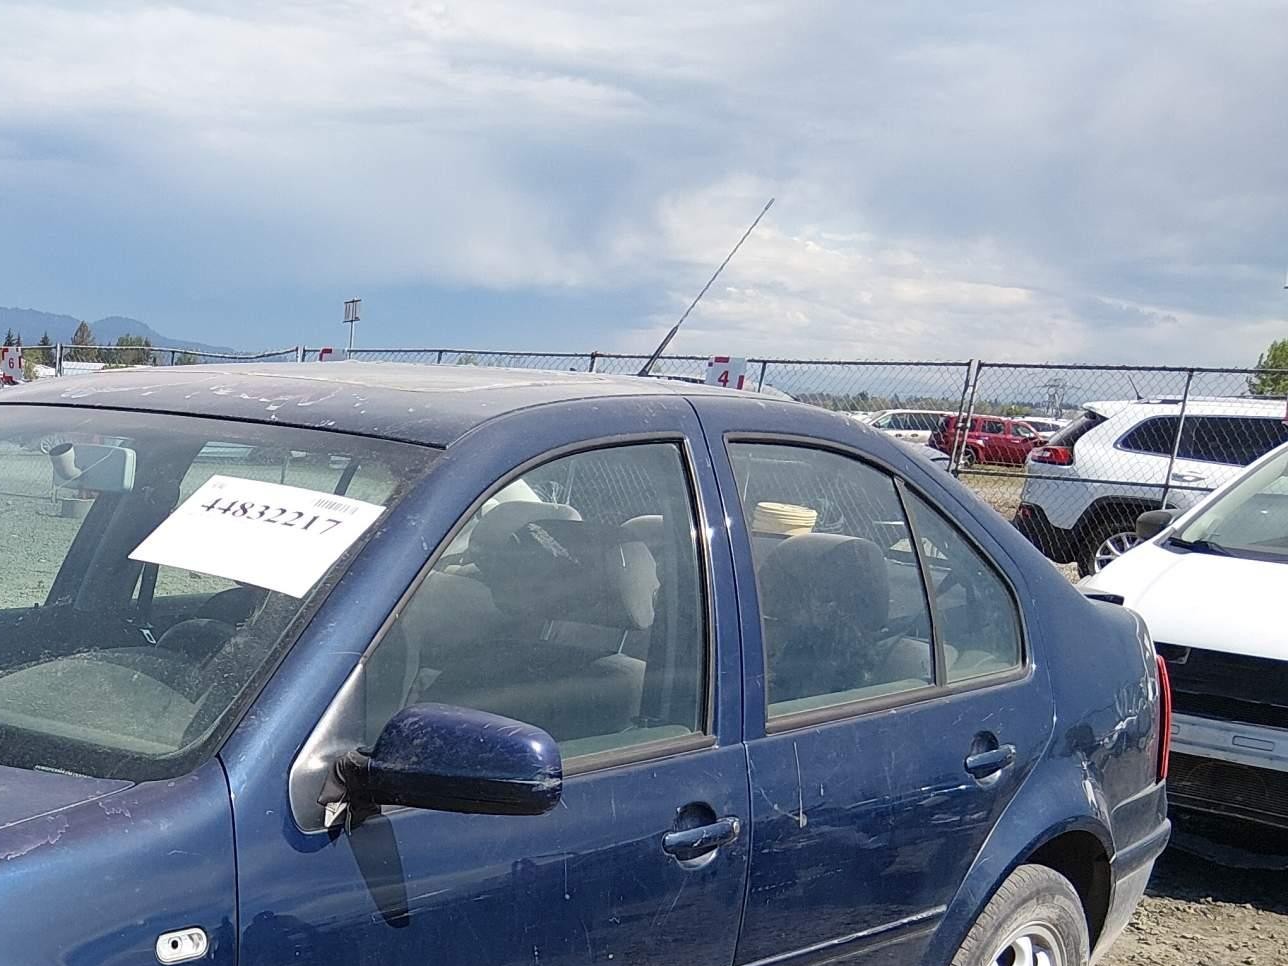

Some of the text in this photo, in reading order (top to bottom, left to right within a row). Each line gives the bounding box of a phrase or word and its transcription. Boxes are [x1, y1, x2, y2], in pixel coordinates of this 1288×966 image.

[8, 357, 15, 369] 6
[717, 370, 729, 387] 4
[201, 497, 343, 535] 44832217
